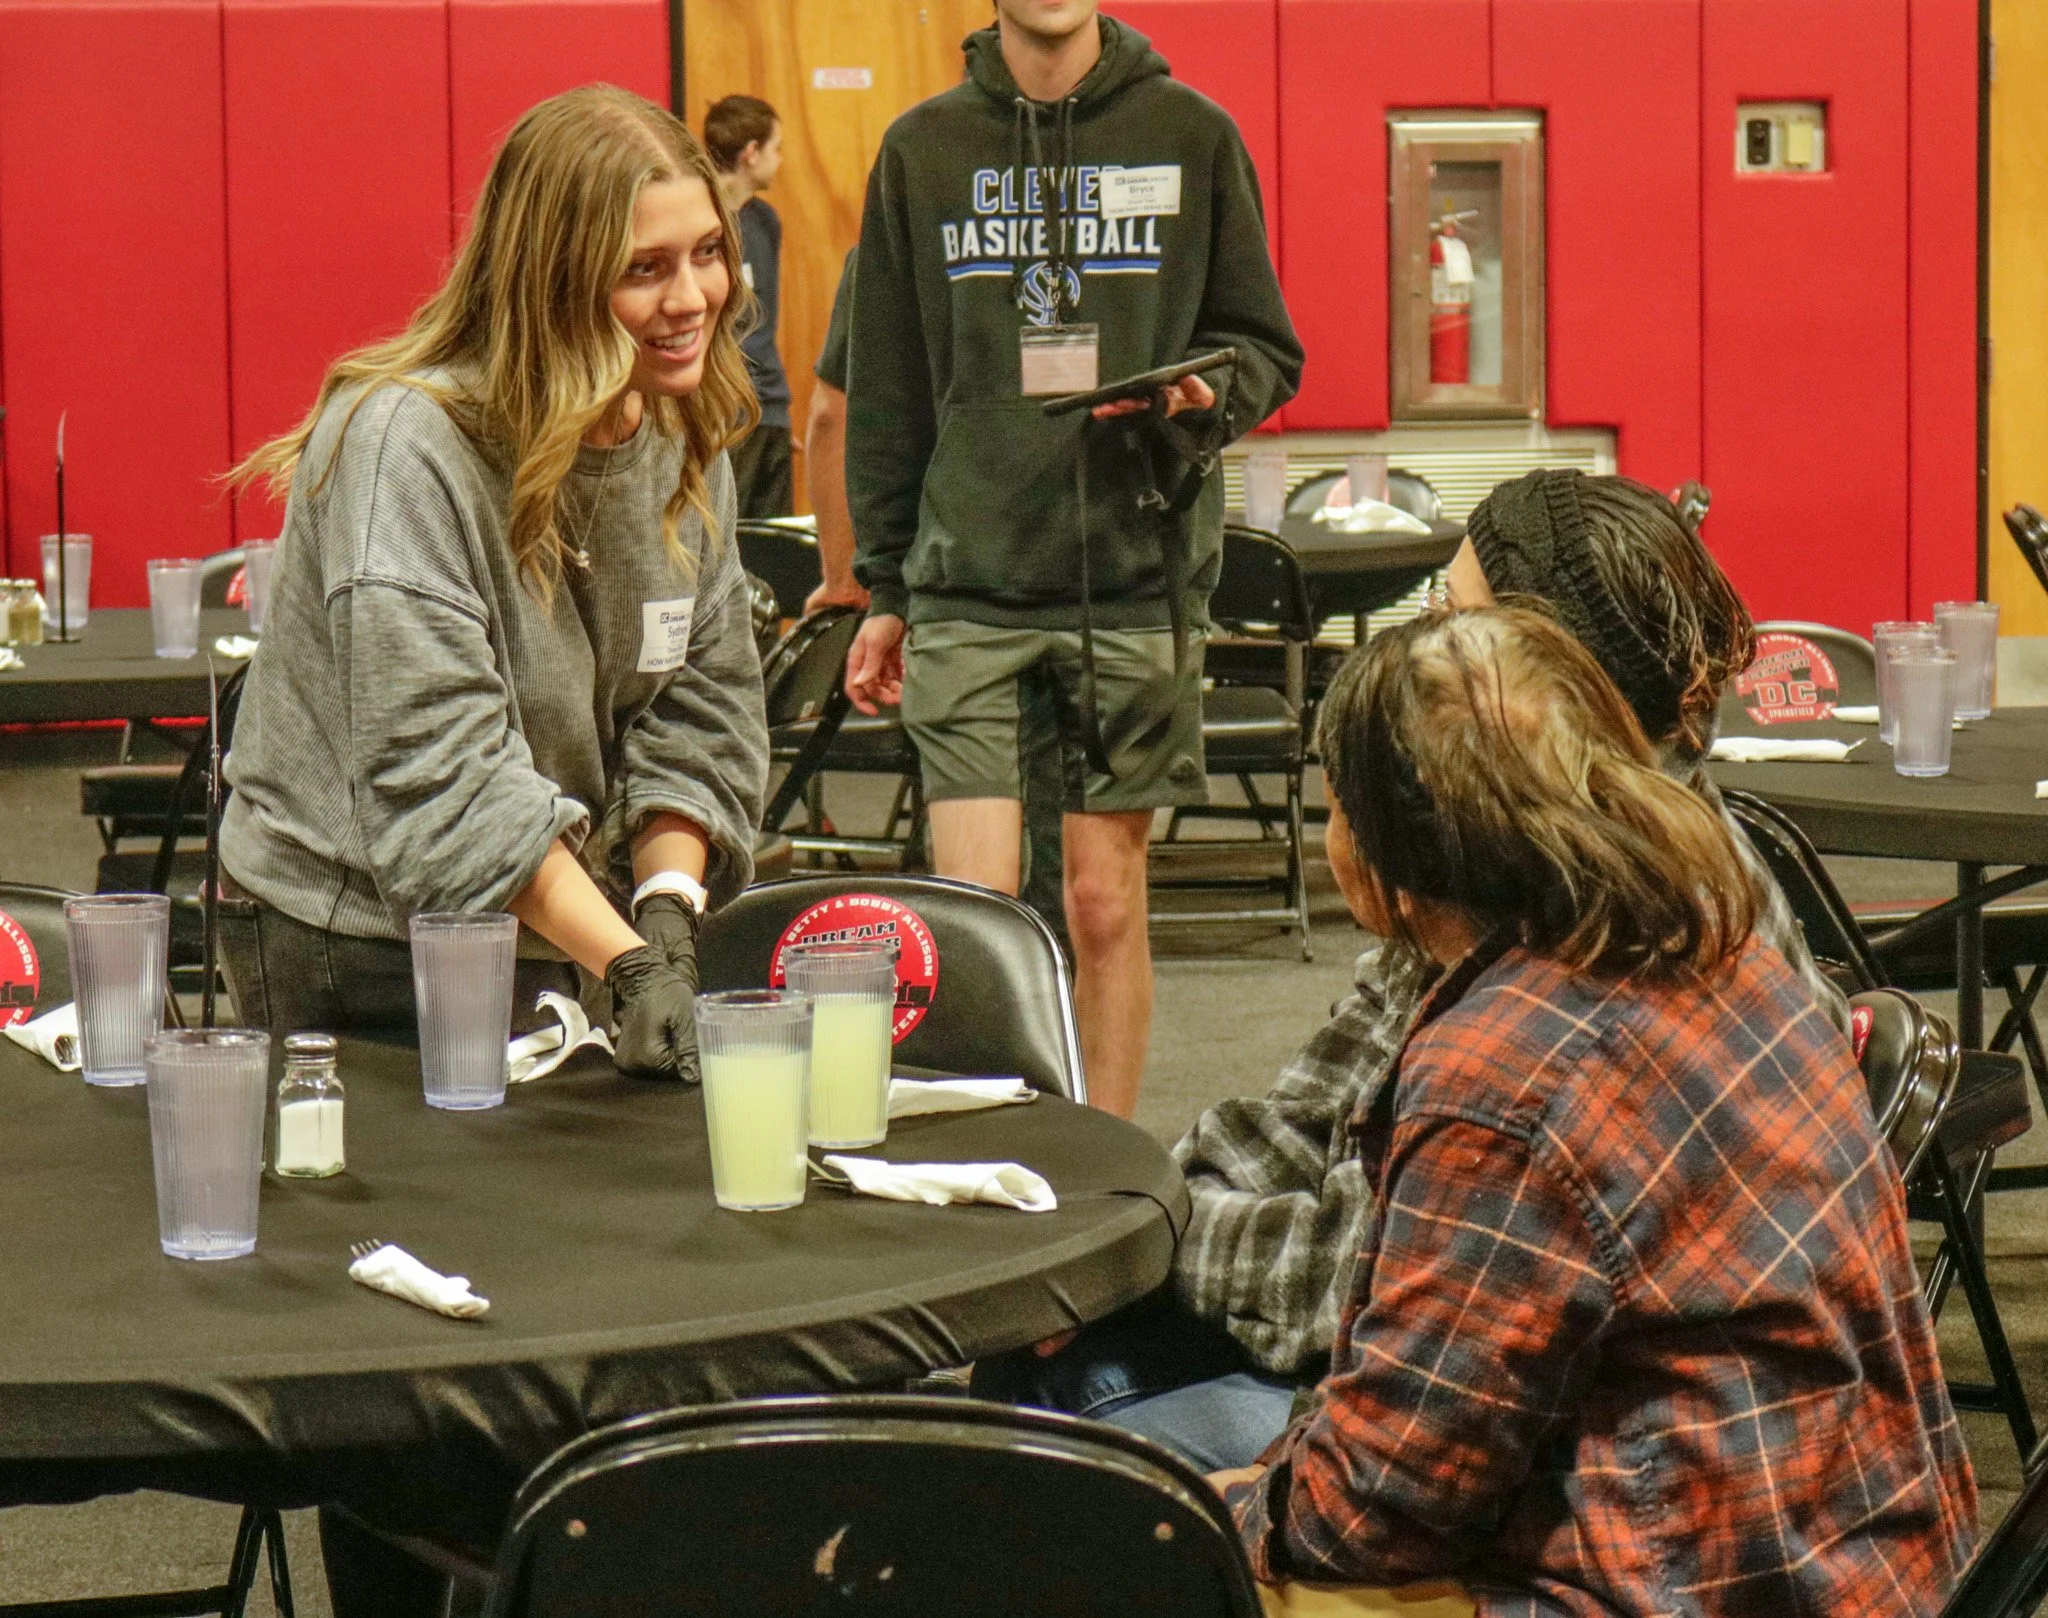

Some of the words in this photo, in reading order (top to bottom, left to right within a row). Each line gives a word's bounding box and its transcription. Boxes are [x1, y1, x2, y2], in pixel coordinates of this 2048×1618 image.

[973, 165, 1125, 214] CLEVE
[1129, 185, 1155, 195] Bryce
[647, 657, 664, 667] HOW
[1754, 680, 1818, 708] DC
[786, 904, 829, 942] BETTY
[835, 899, 844, 909] &
[849, 898, 901, 915] BOBBY
[902, 914, 933, 976] ALLISON
[801, 919, 898, 945] DREAM
